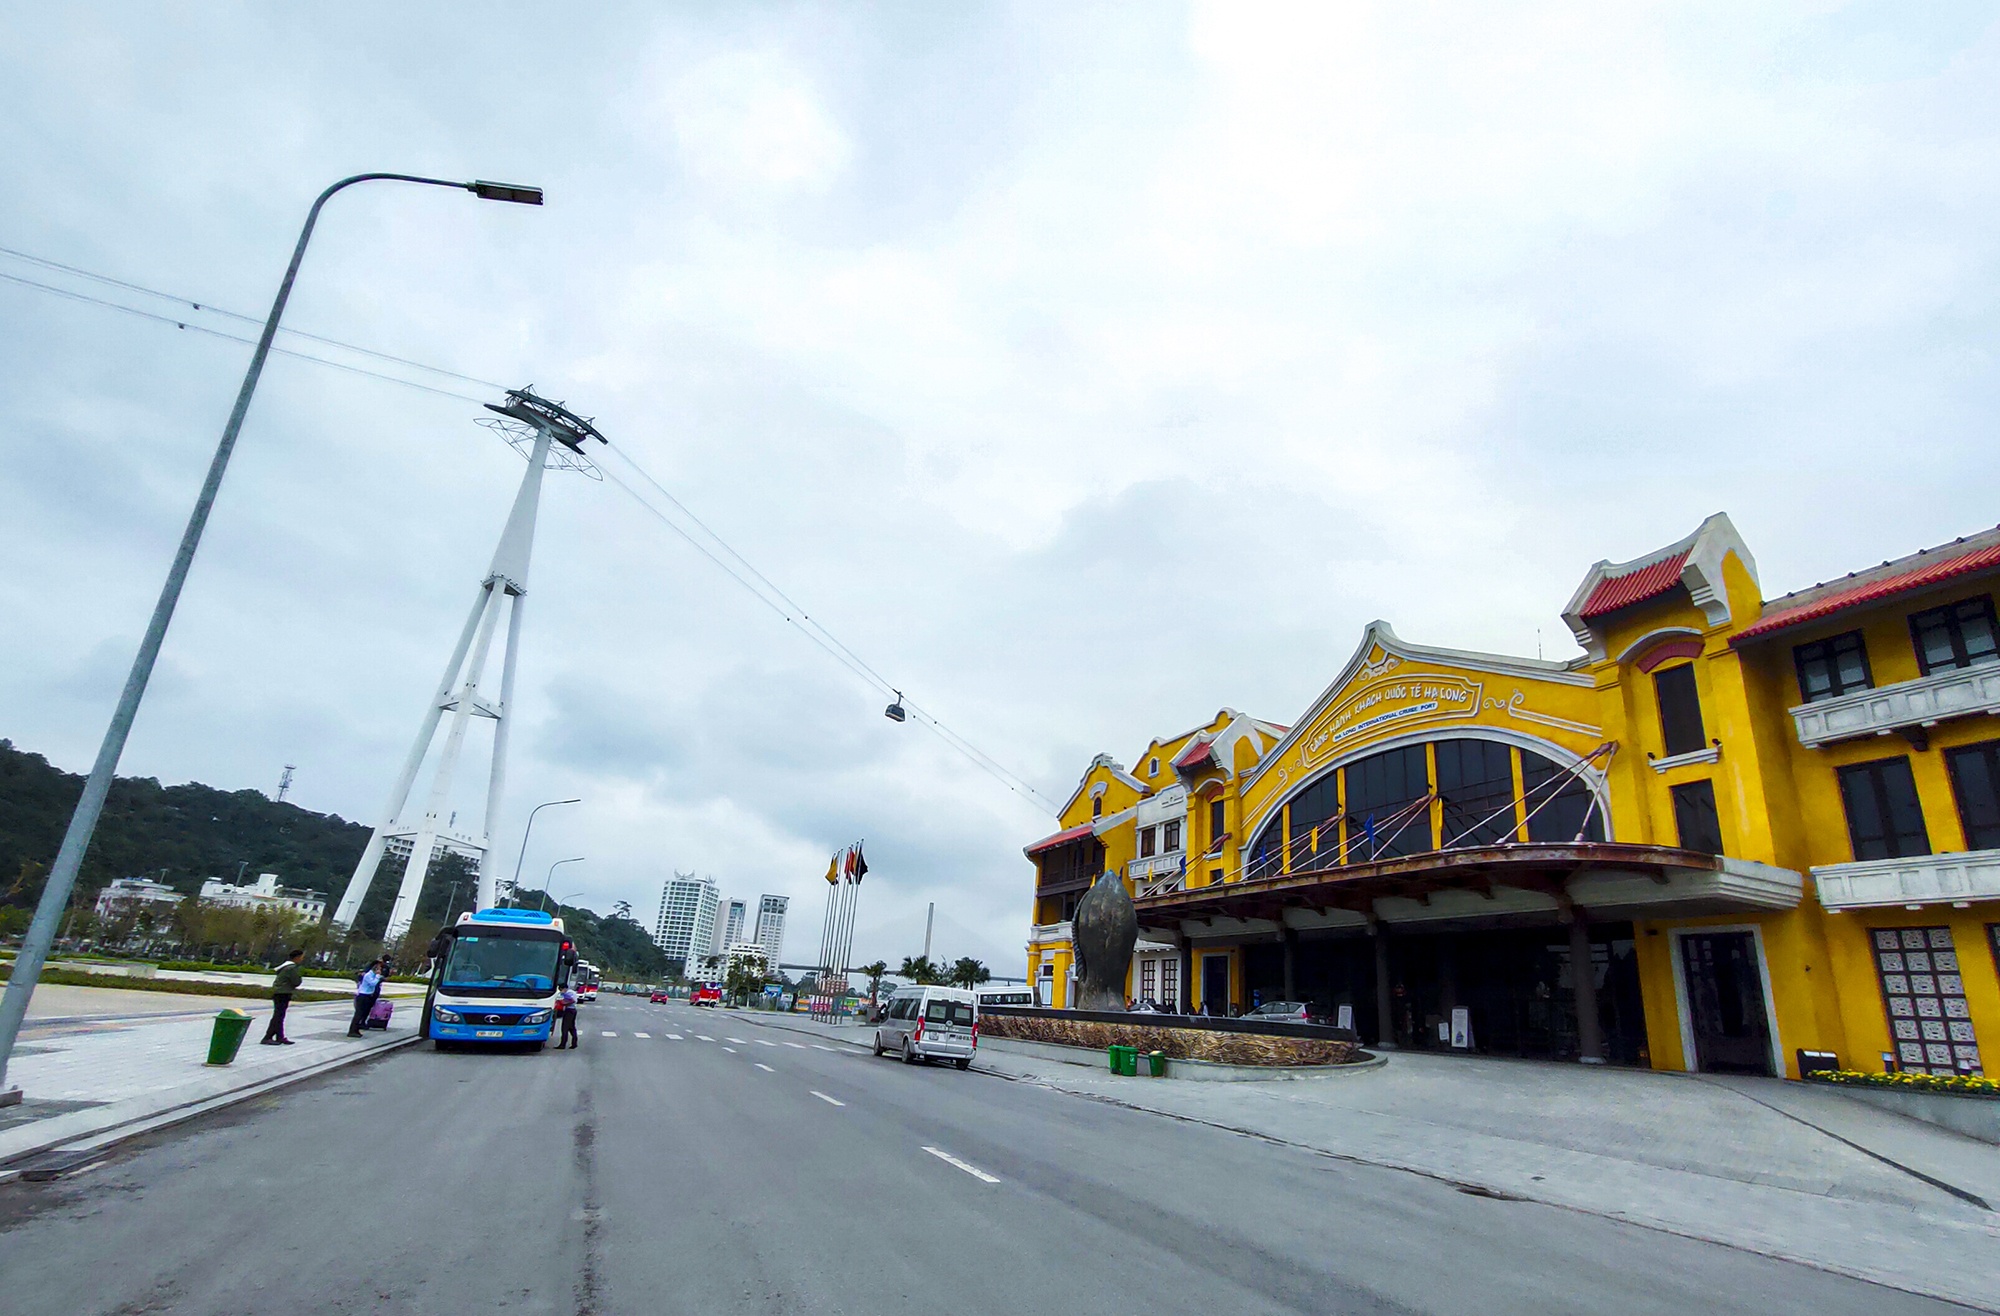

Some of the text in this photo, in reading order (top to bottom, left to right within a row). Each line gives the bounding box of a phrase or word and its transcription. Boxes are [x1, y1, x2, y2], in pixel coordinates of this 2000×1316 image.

[1440, 688, 1467, 702] LONG
[1342, 727, 1356, 736] LONG
[1357, 712, 1397, 730] INTERNATIONAL
[1398, 706, 1418, 716] CRUISE
[1420, 702, 1436, 710] PORT
